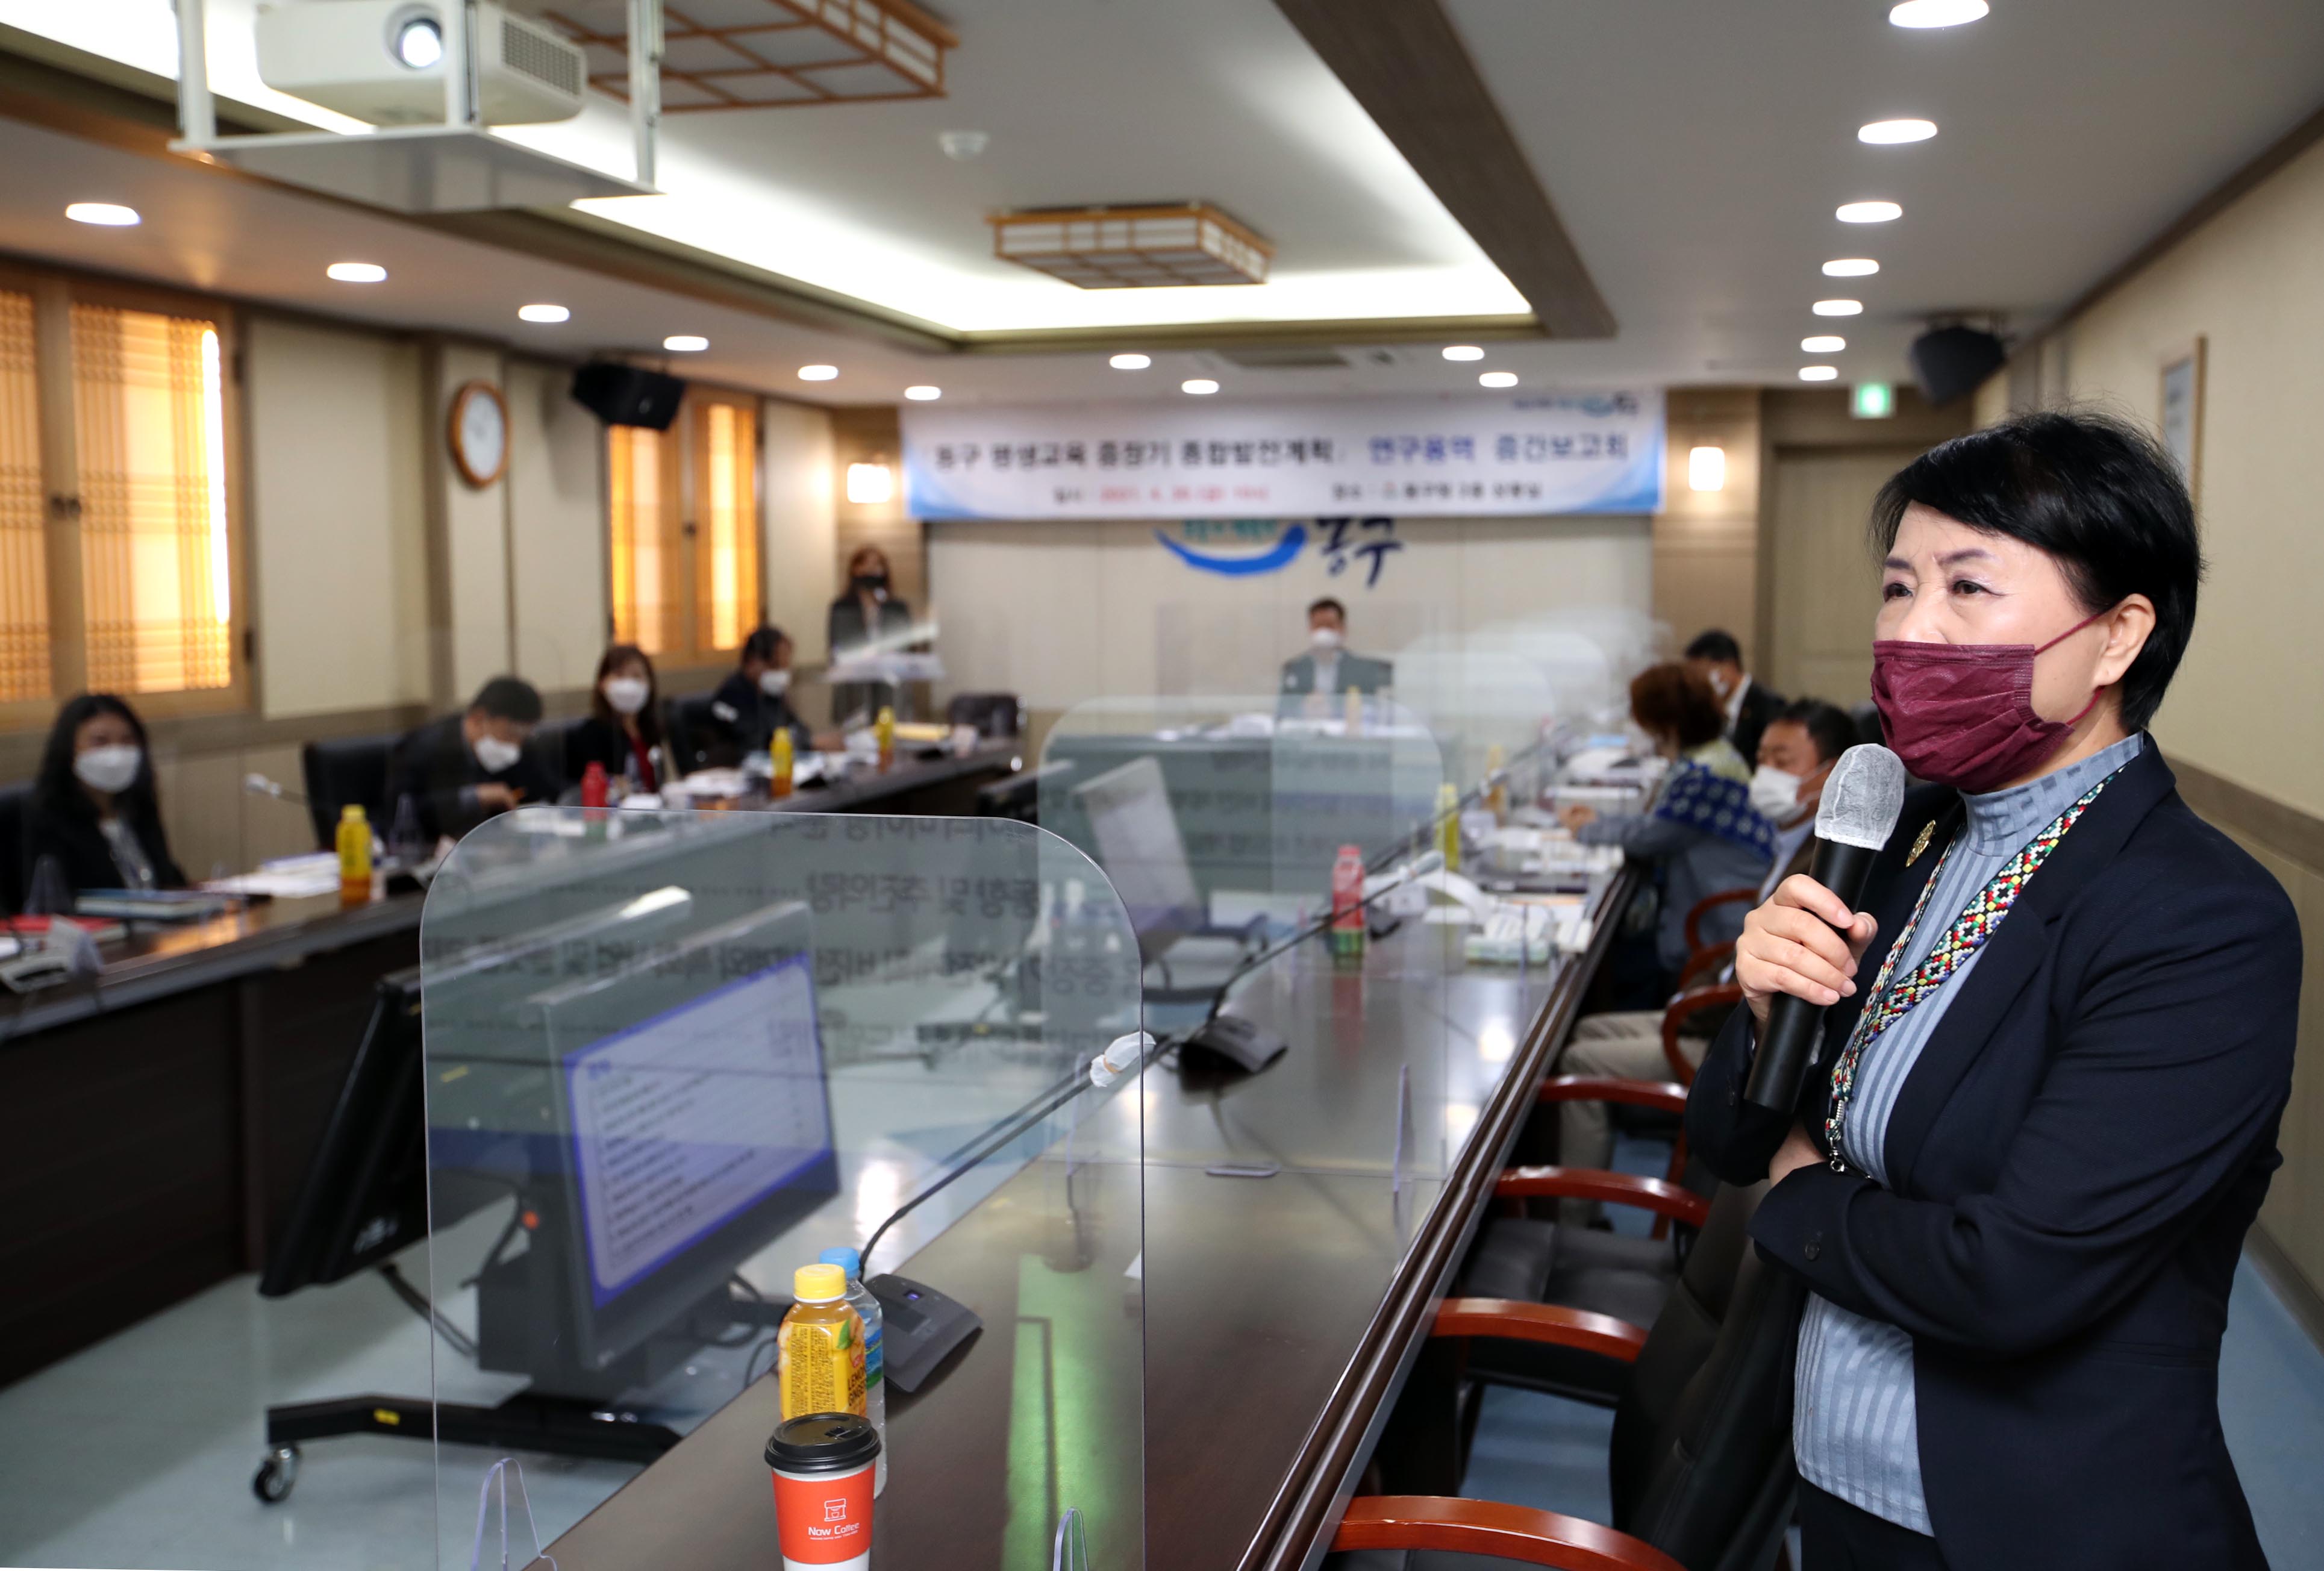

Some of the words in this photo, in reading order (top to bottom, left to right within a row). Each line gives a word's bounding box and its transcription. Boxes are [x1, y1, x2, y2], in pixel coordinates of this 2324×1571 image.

[1369, 436, 1475, 463] 연구용역
[808, 1526, 831, 1536] Now
[834, 1522, 860, 1535] Coffee
